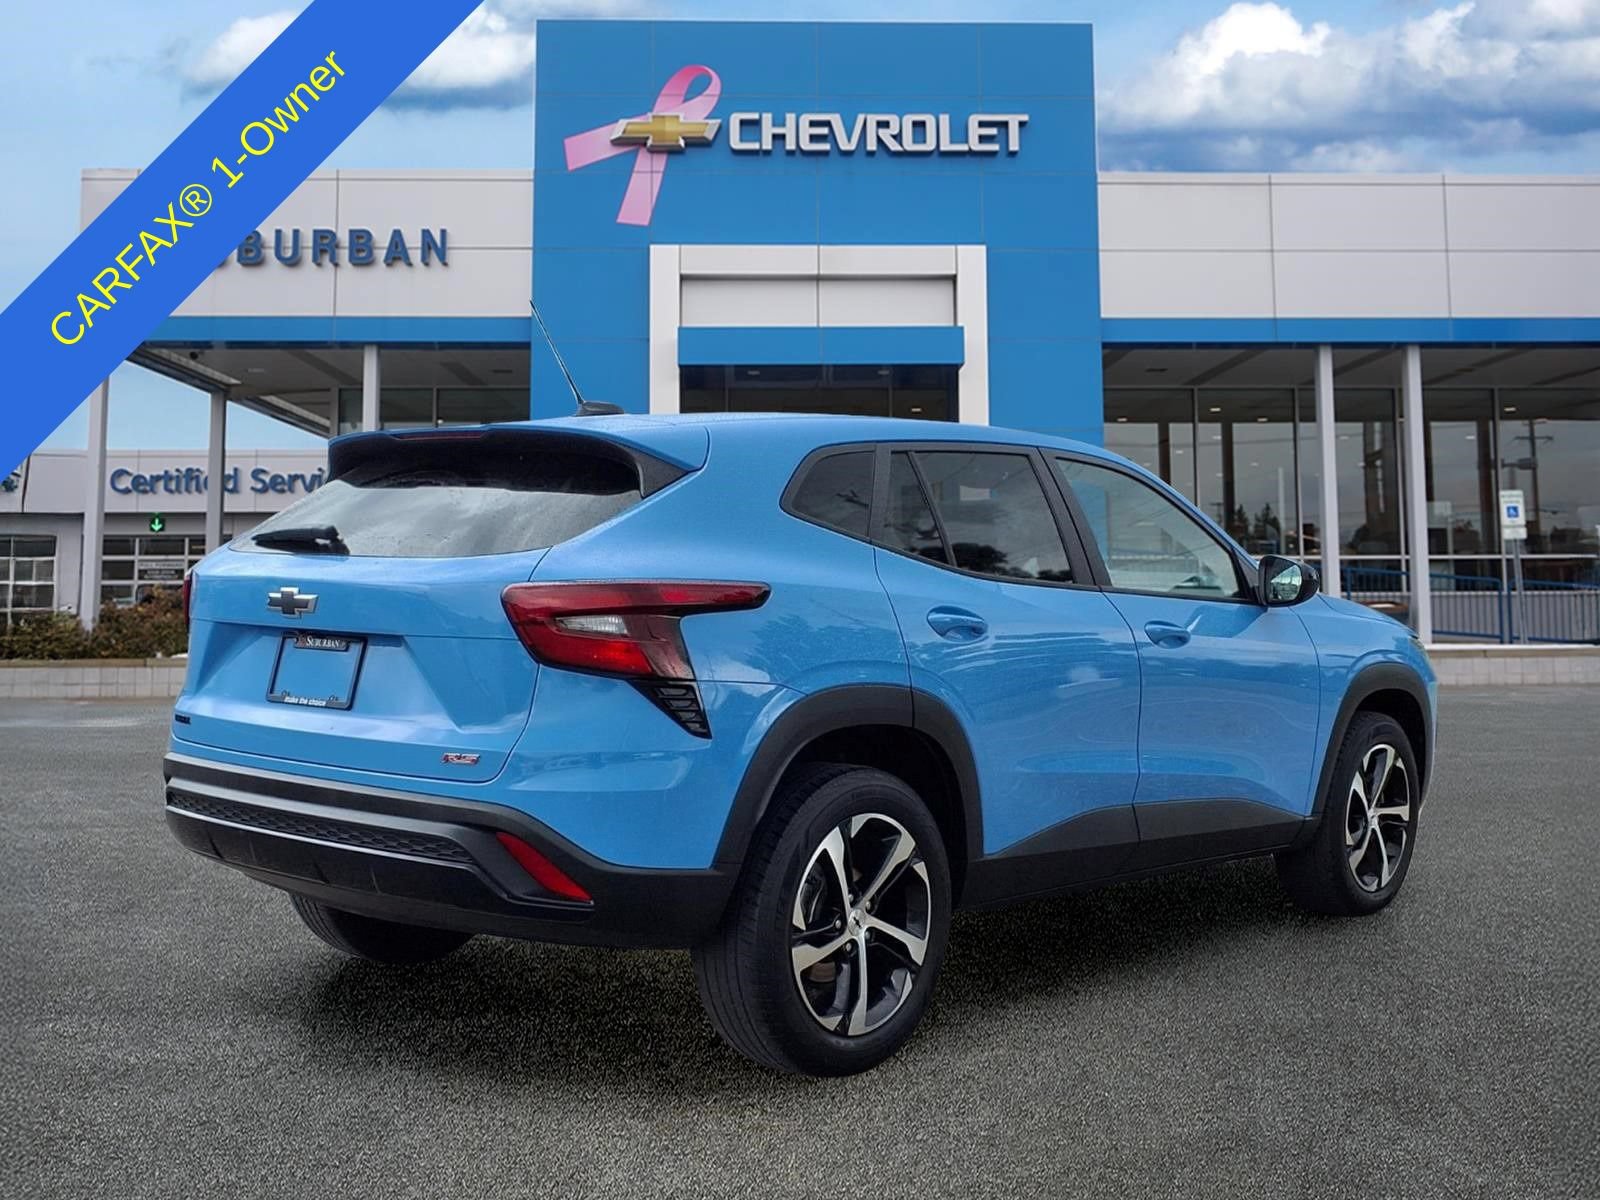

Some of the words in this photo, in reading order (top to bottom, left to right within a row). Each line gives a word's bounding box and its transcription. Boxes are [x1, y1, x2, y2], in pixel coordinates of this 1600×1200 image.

[729, 112, 1029, 152] CHEVROLET
[217, 228, 449, 267] BURBAN
[110, 467, 240, 494] Certifid
